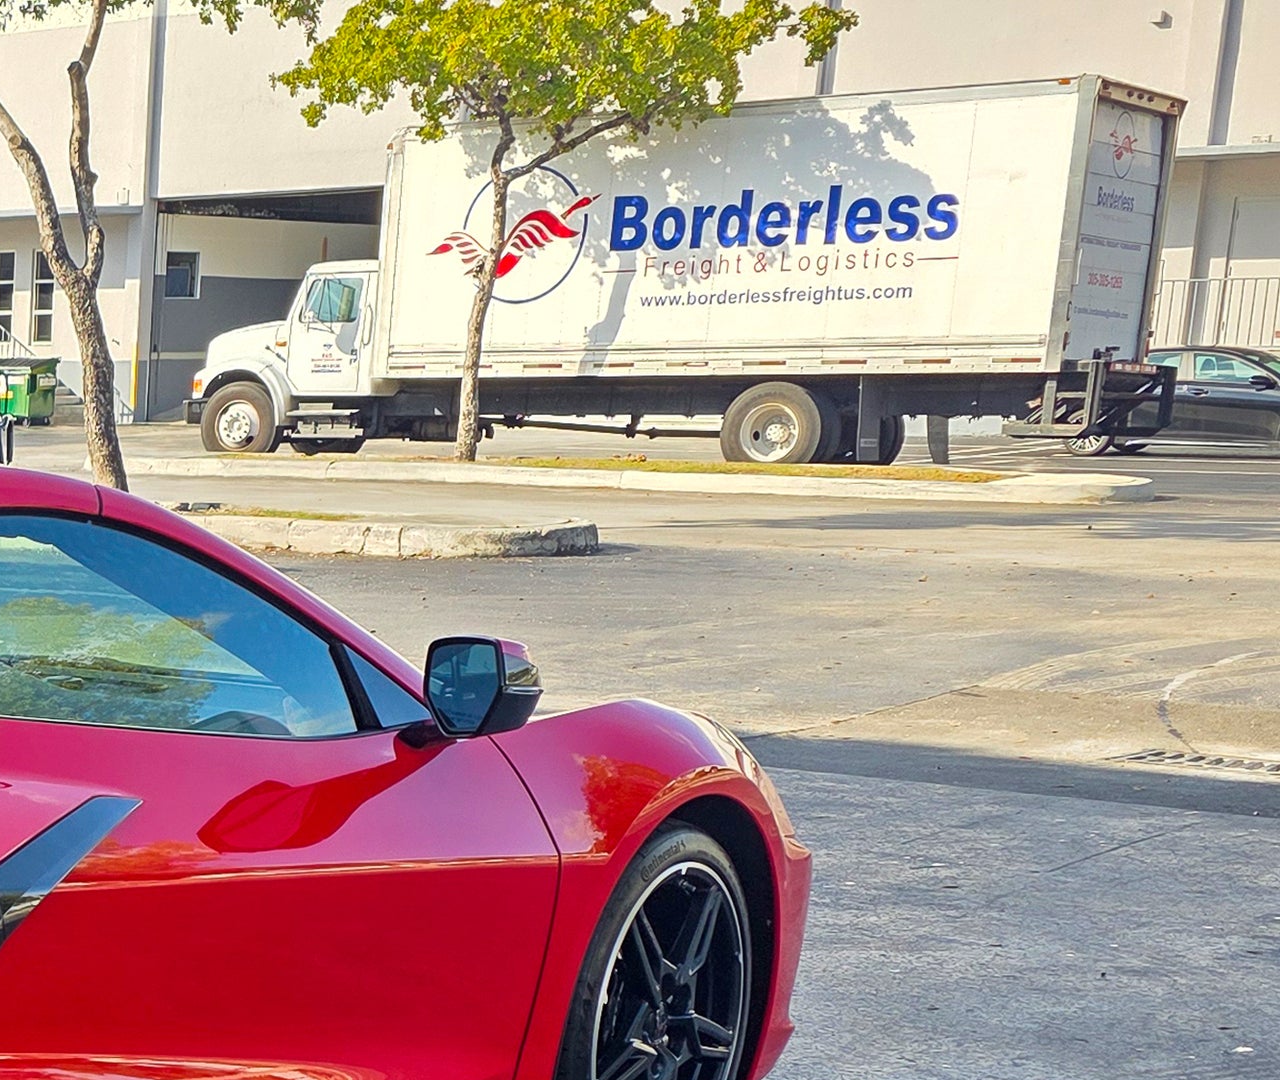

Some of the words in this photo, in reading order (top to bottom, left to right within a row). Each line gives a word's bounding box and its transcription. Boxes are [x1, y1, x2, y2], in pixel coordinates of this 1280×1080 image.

[1096, 186, 1135, 212] Borderless
[609, 184, 960, 252] Borderless
[643, 253, 743, 280] Freight
[753, 251, 769, 274] &
[780, 248, 915, 276] Logistics
[640, 284, 914, 308] www.borderlessfreightus.com
